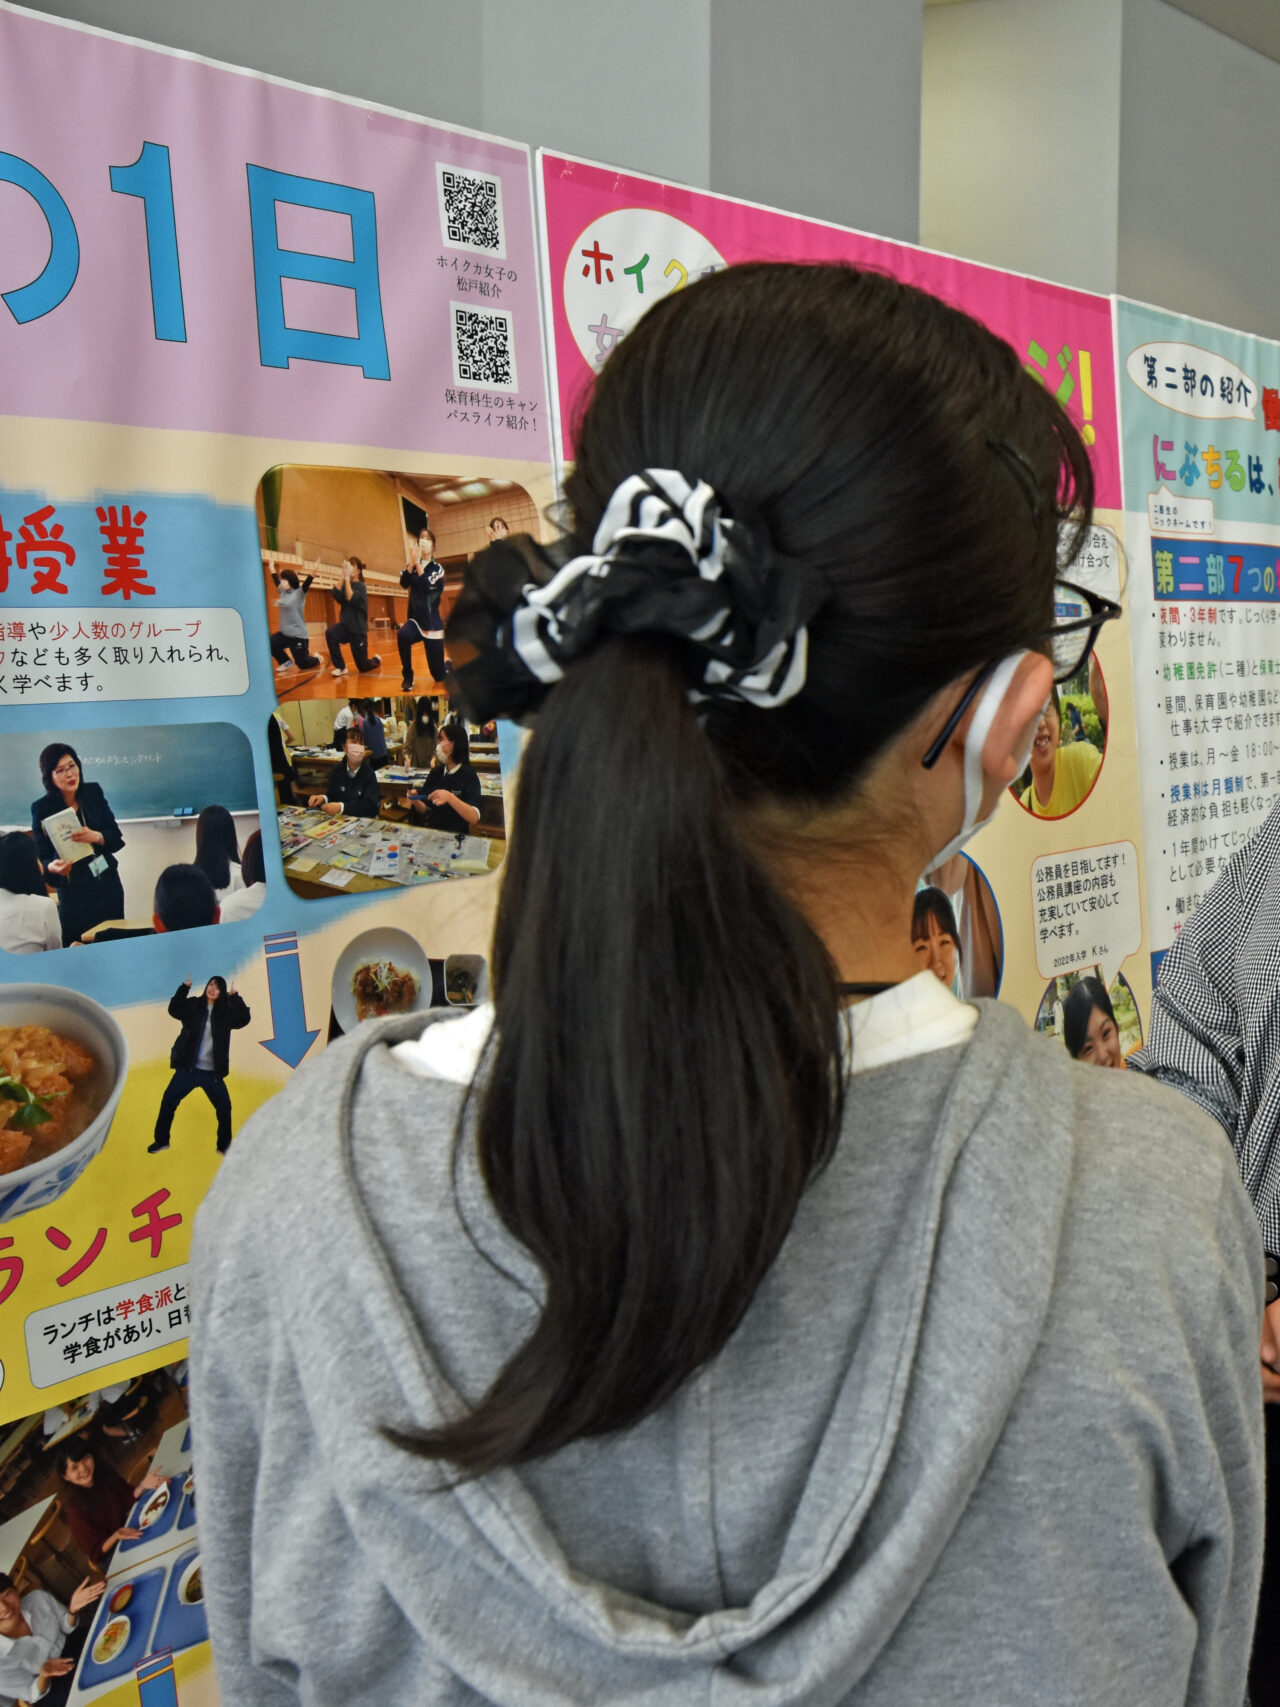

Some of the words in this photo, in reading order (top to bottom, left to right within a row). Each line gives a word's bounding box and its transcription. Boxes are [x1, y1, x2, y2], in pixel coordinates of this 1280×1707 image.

[582, 241, 728, 294] ホイク
[457, 276, 502, 298] 松戸紹介
[1143, 353, 1252, 407] 第二部の紹介
[445, 388, 538, 411] 保育科生のキャン
[1159, 631, 1220, 648] 変わりません。
[1036, 853, 1126, 882] 公務員を目指してます！
[1037, 872, 1116, 902] 公務員講座の内容も
[1039, 892, 1119, 923] 充実していて安心して
[1040, 921, 1079, 943] 学べます。
[1054, 950, 1087, 967] 2022年入学
[43, 1284, 190, 1344] ランチは学食派と
